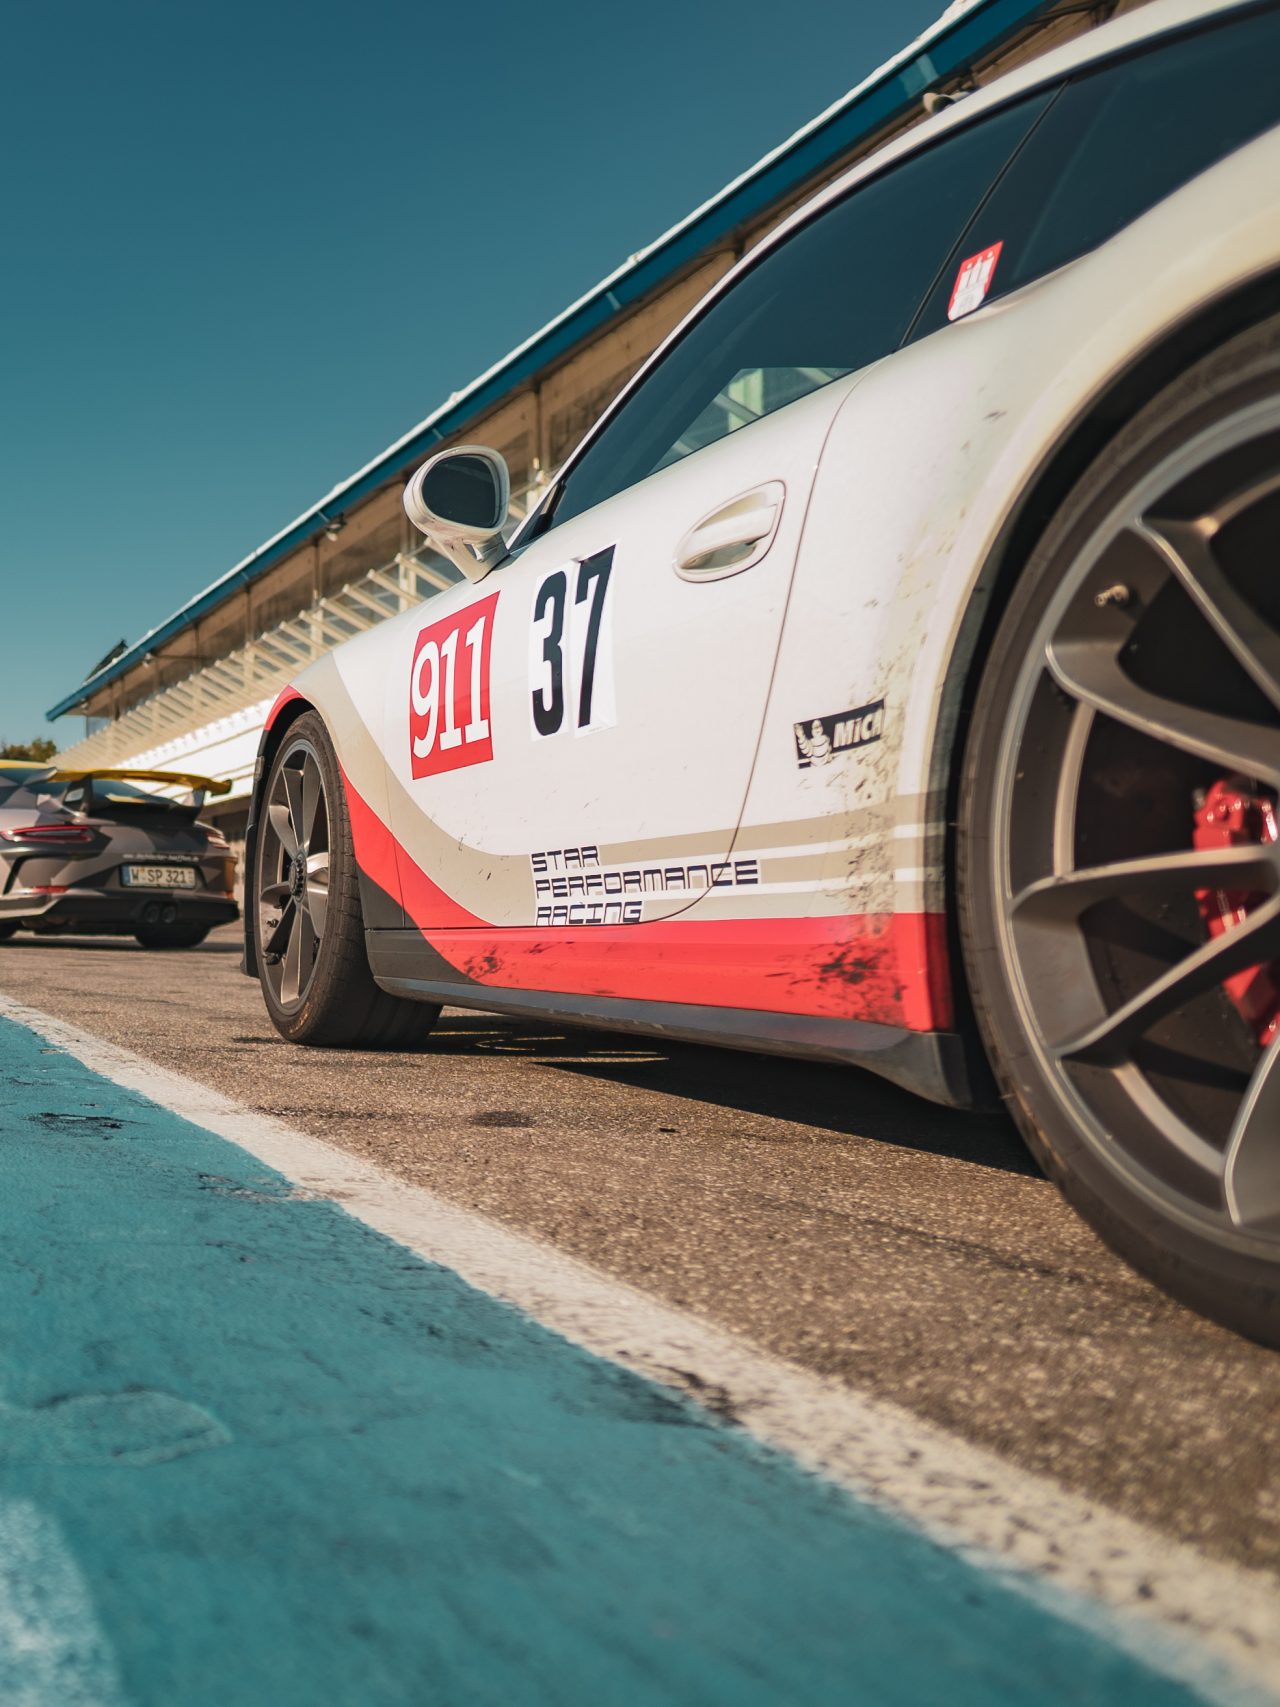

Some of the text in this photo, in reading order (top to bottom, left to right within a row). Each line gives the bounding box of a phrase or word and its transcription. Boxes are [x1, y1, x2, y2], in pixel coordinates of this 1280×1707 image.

[532, 544, 616, 736] 37
[411, 615, 490, 759] 911
[531, 845, 600, 872] STAR
[147, 869, 163, 883] SP
[166, 869, 187, 884] 321
[535, 860, 759, 899] PERFORMANCE
[536, 901, 642, 926] RACING
